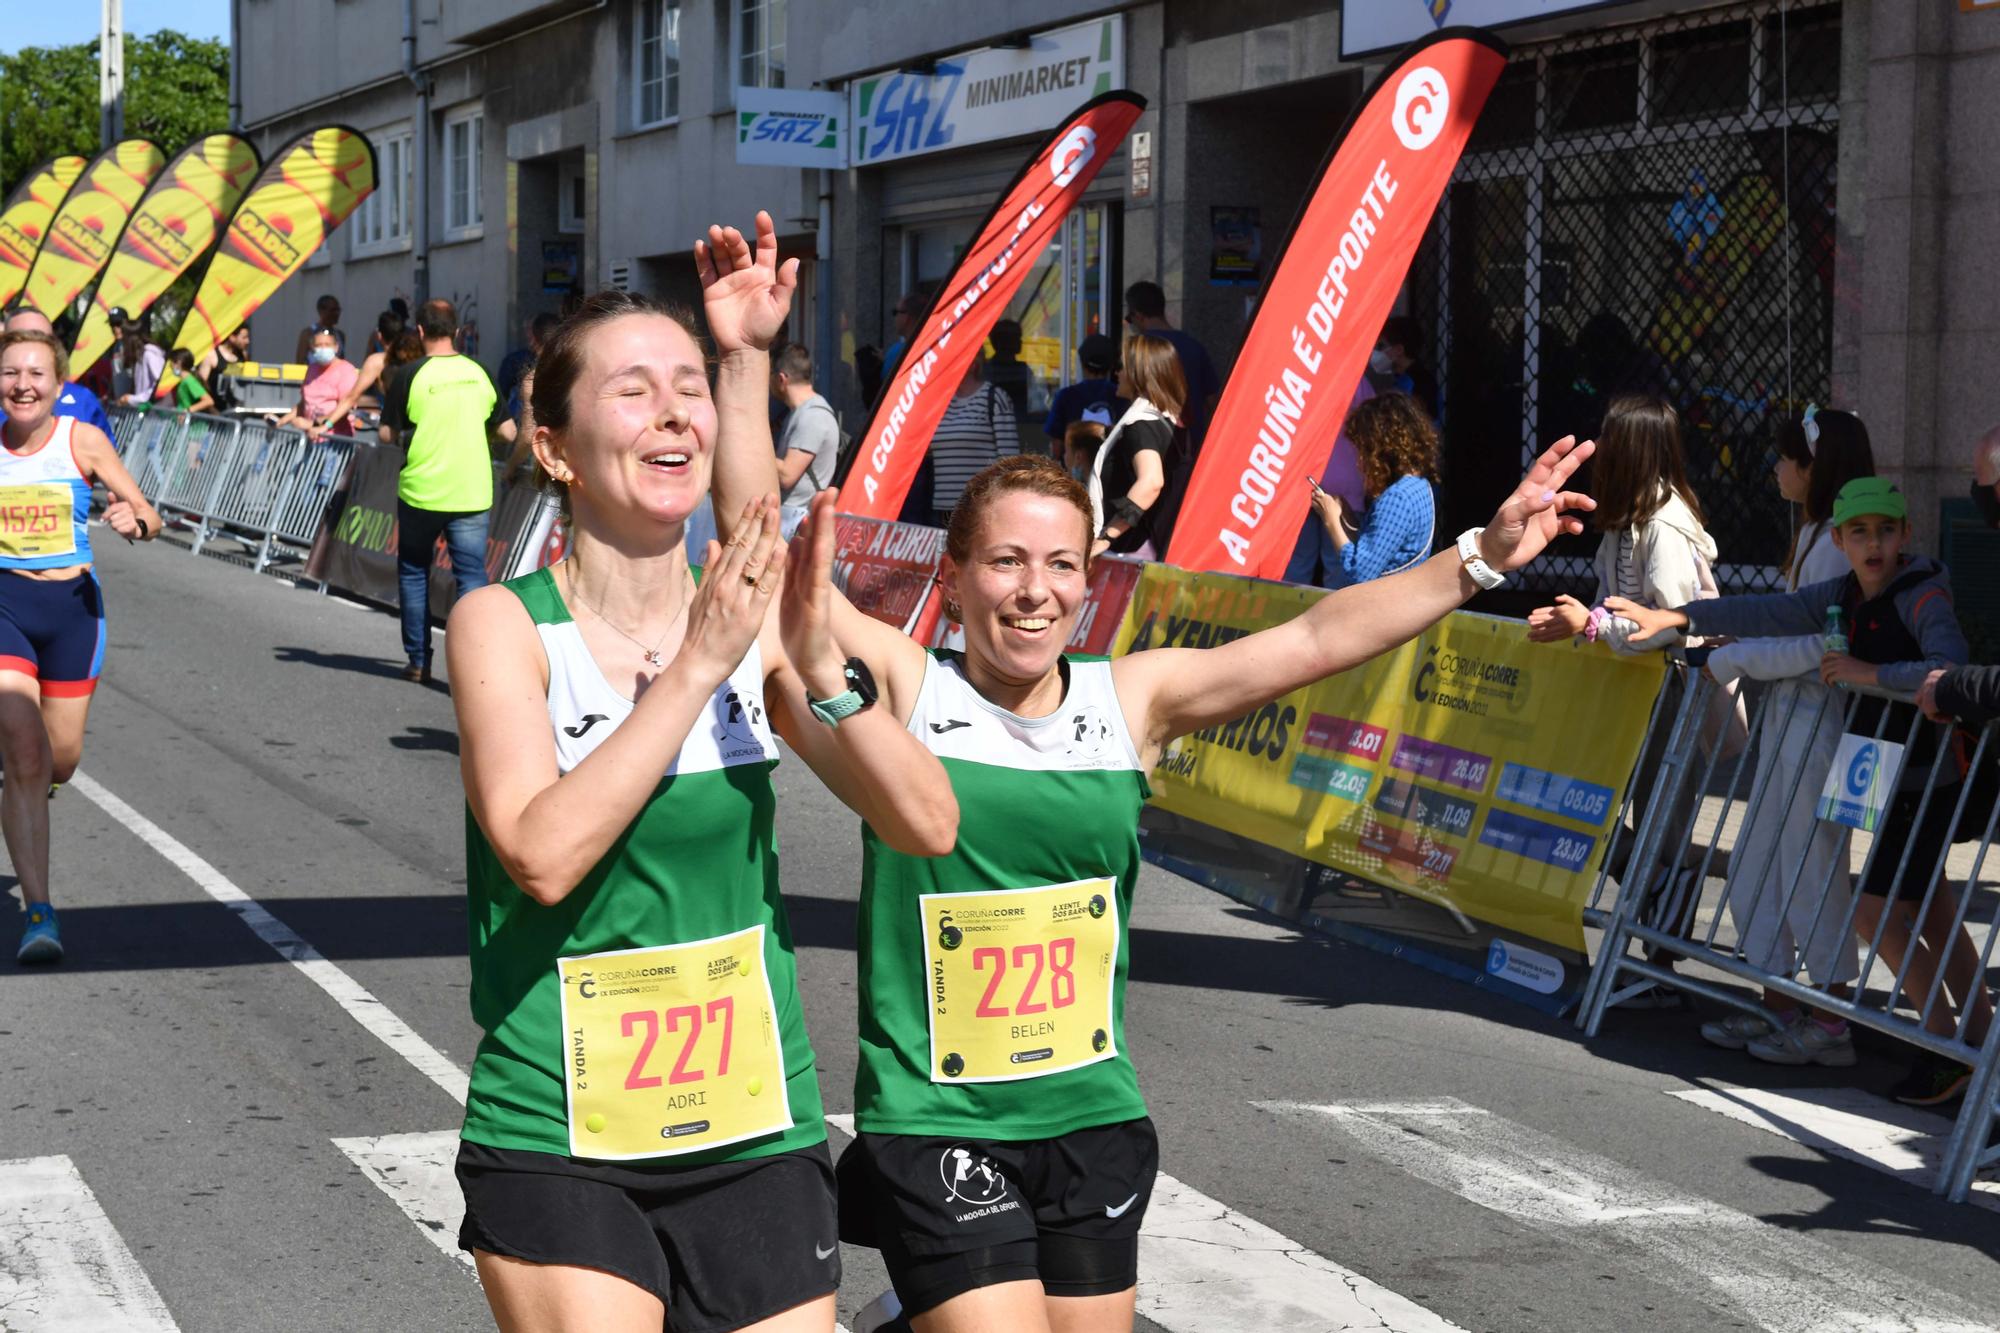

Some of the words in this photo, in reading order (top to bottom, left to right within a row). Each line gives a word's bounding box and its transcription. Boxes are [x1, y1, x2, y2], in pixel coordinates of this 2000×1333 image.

[768, 110, 826, 121] MINIMARKET
[869, 57, 970, 159] SAZ
[966, 56, 1092, 110] MINIMARKET
[752, 118, 824, 144] SAZ
[134, 215, 191, 264] GADIS
[236, 212, 297, 267] GADIS
[1306, 159, 1400, 345] DEPORTE
[1292, 325, 1324, 376] É
[862, 473, 879, 504] A
[871, 347, 939, 474] CORUÑA
[1231, 367, 1313, 530] CORUÑA
[0, 504, 58, 533] 1525
[1219, 528, 1252, 566] A
[1127, 610, 1159, 656] A
[1327, 769, 1368, 795] 22.05
[1452, 758, 1487, 783] 26.03
[1563, 787, 1608, 816] 08.05
[1441, 803, 1471, 828] 11.09
[1551, 836, 1588, 862] 23.10
[956, 907, 1026, 919] CORUÑACORRE
[1052, 903, 1058, 911] A
[1058, 901, 1081, 911] XENTE
[1052, 910, 1067, 919] DOS
[599, 966, 677, 981] CORUÑACORRE
[934, 958, 946, 1004] TANDA
[972, 937, 1076, 1018] 228
[609, 986, 640, 996] EDICIÓN
[937, 1007, 947, 1015] 2
[621, 996, 734, 1090] 227
[1011, 1021, 1055, 1039] BELEN
[573, 1027, 587, 1077] TANDA
[576, 1082, 588, 1090] 2
[667, 1091, 707, 1110] ADRI
